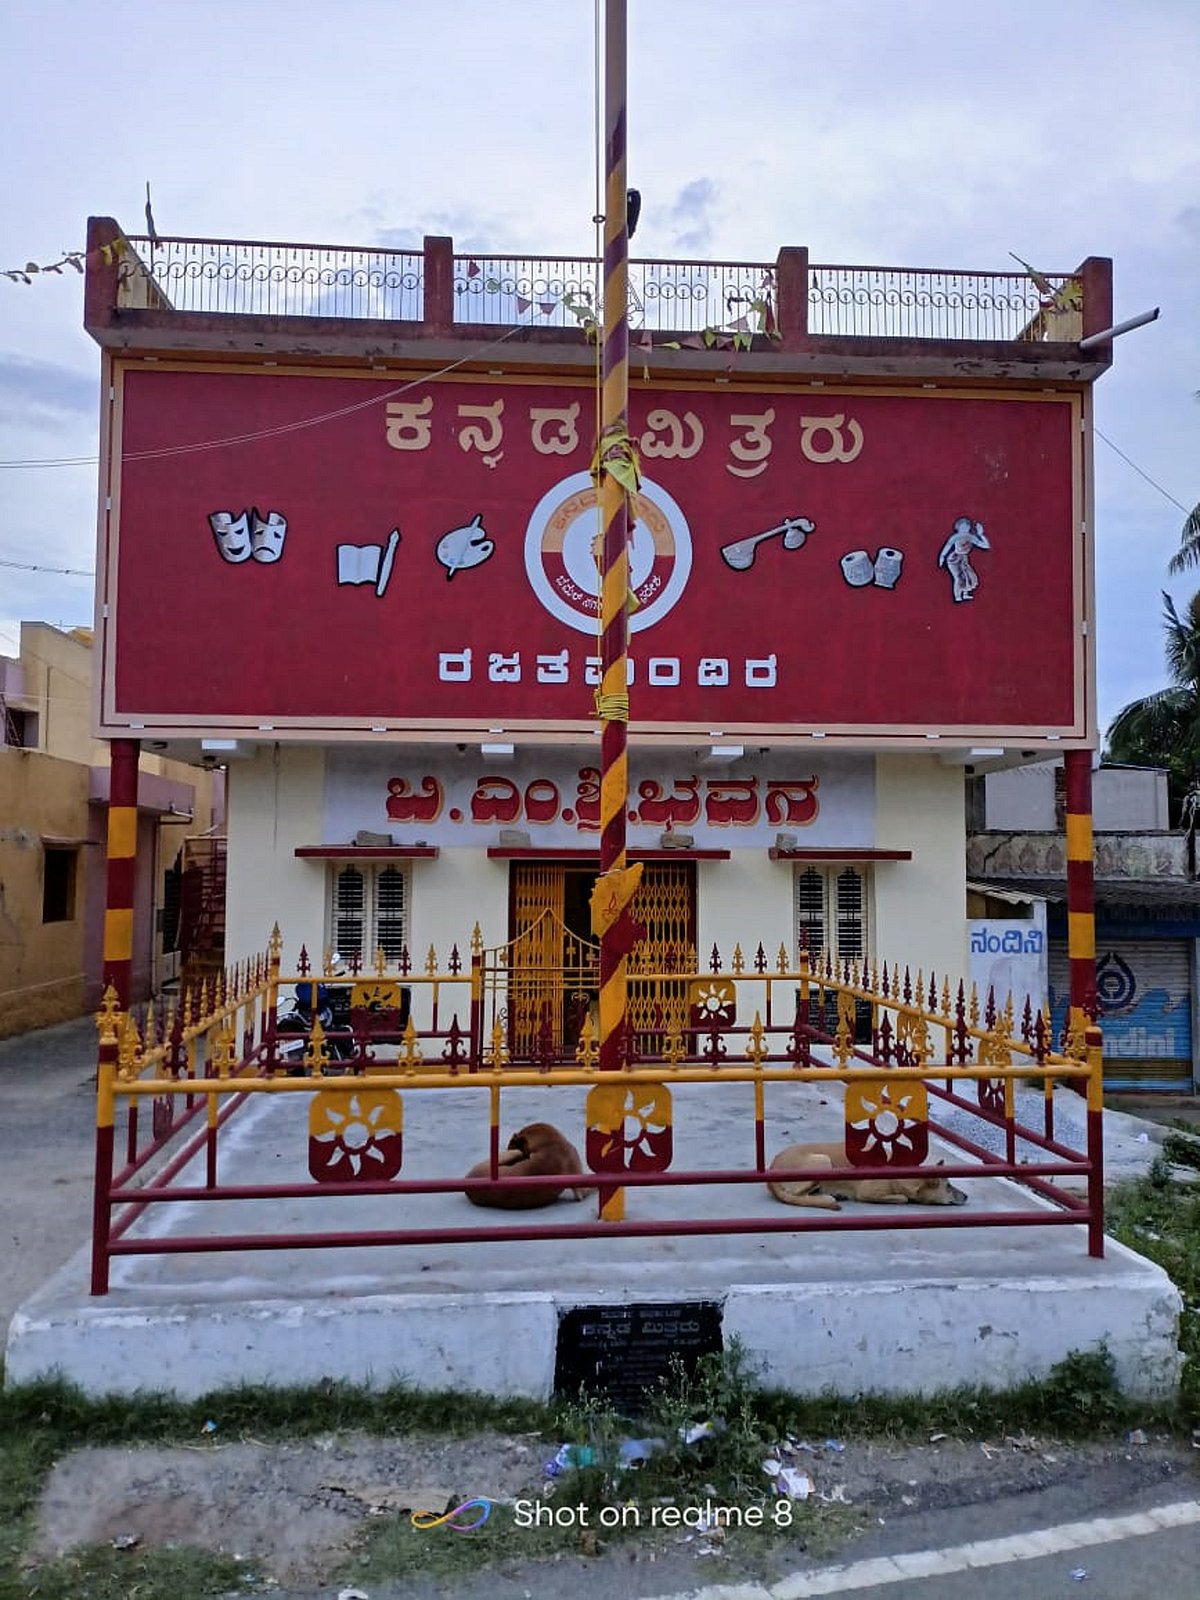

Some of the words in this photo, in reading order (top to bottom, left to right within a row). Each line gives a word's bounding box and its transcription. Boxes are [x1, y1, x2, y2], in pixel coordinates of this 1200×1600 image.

[386, 396, 581, 469] ಕನ್ನಡ
[640, 407, 864, 478] ಮಿತ್ರರು
[971, 928, 1043, 954] ನಂದಿನಿ
